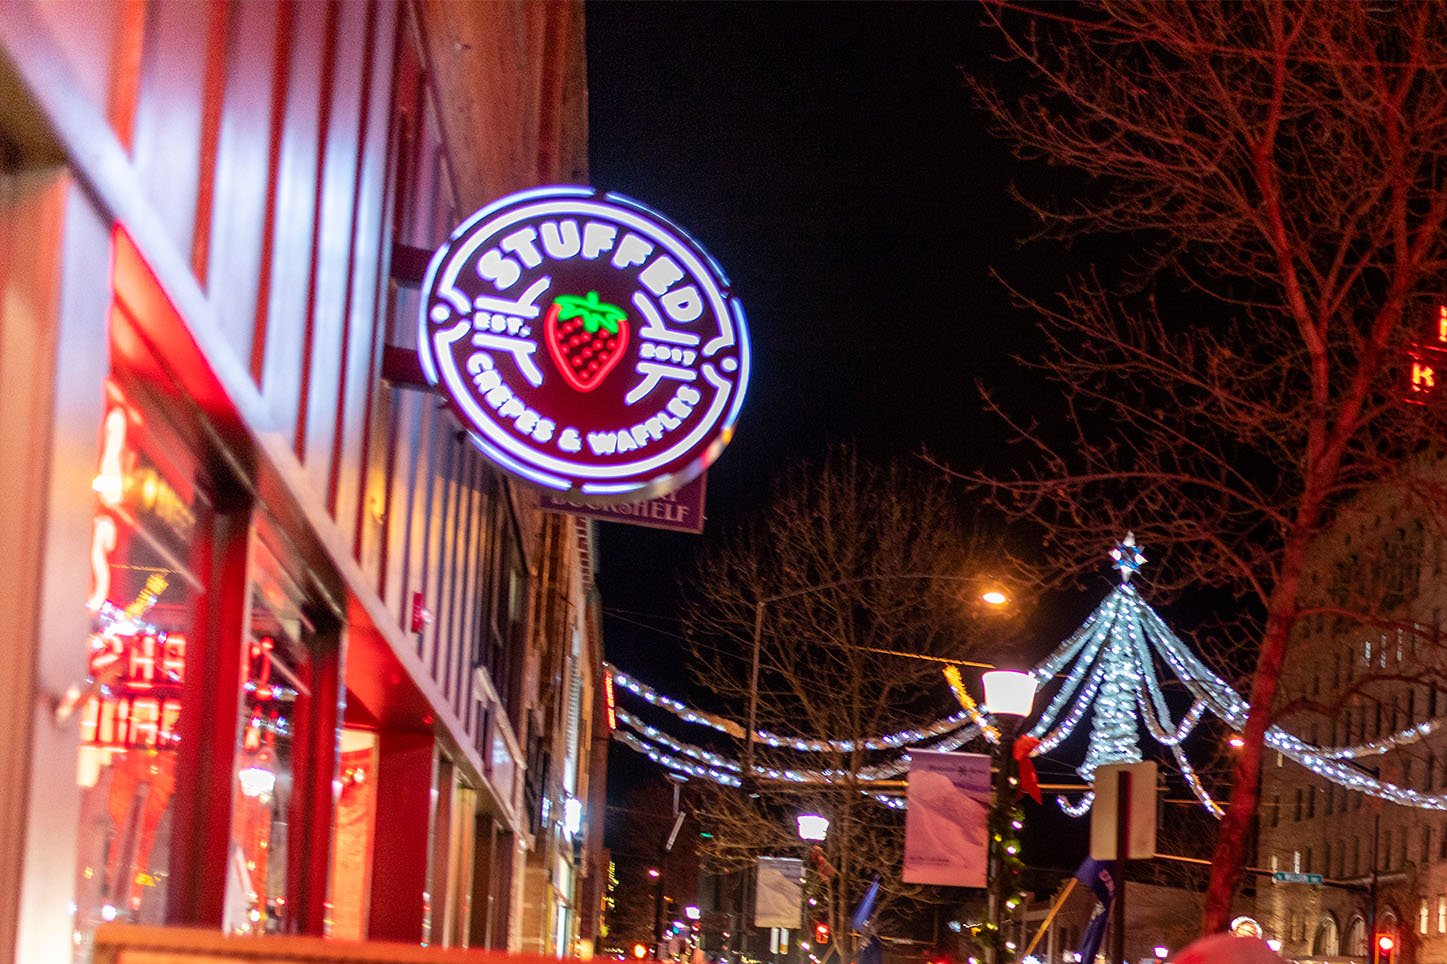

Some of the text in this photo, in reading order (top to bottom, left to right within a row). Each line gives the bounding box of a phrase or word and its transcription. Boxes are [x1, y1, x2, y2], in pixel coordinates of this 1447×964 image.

[475, 219, 703, 323] STUFFED
[473, 311, 532, 337] EST.
[465, 350, 702, 456] CREPES & WAFFLES
